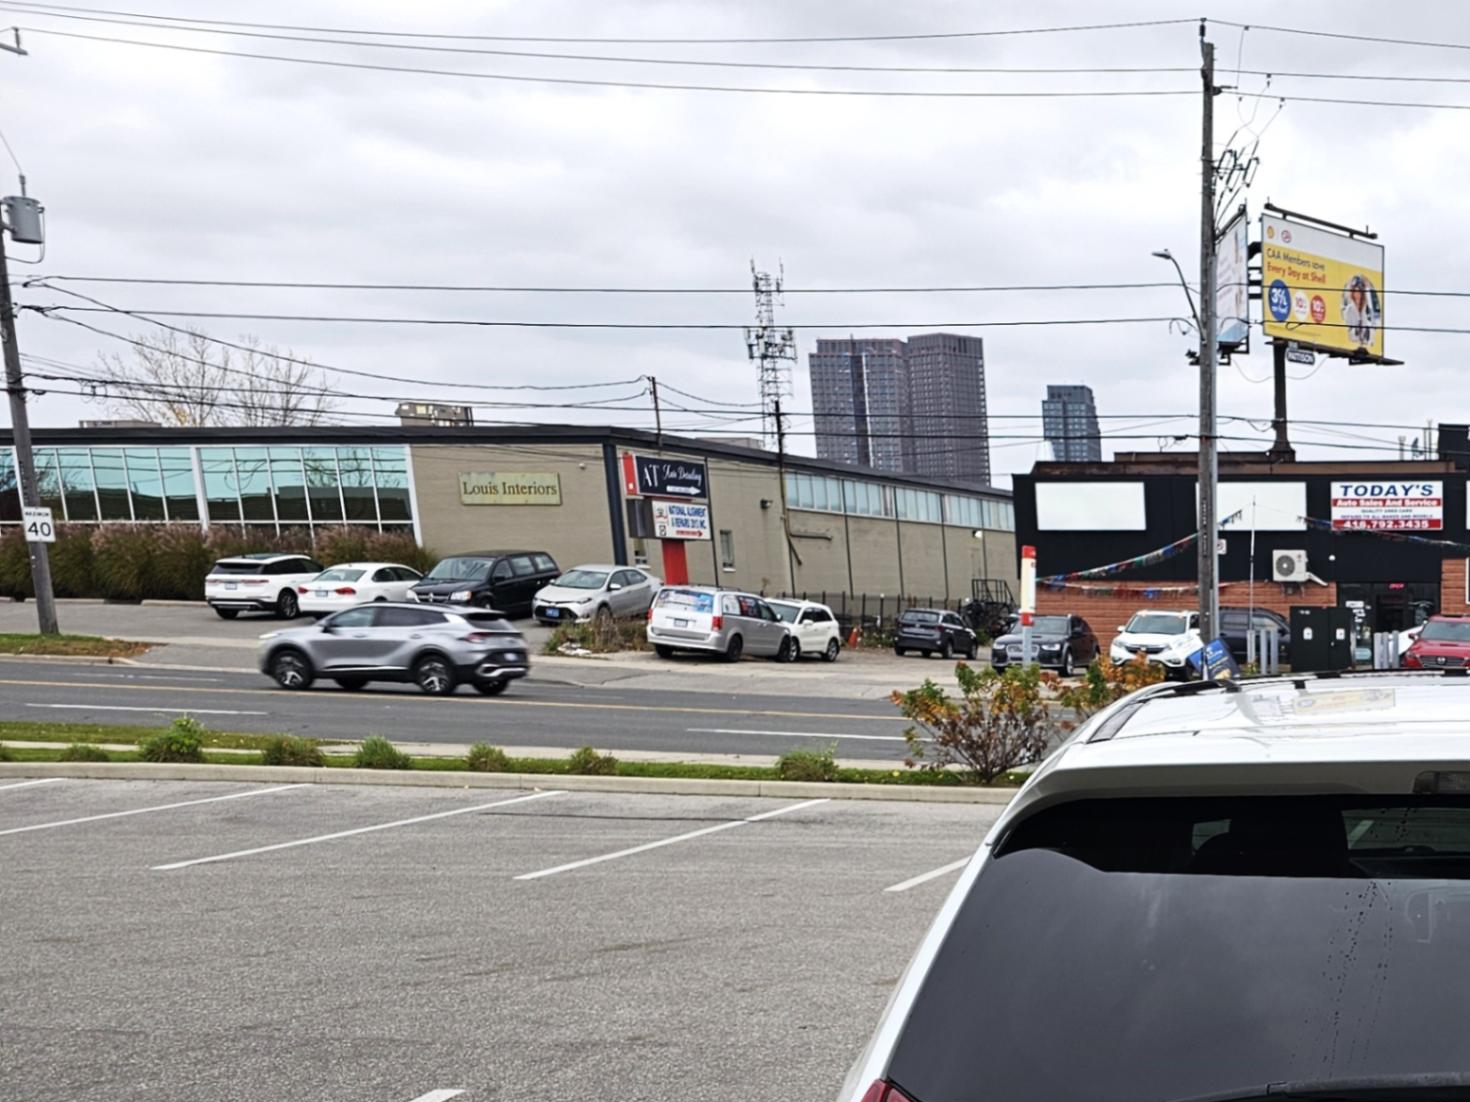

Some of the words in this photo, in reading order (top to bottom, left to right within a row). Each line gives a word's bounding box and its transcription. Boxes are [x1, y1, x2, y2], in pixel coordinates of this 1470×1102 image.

[1266, 248, 1281, 259] CAA
[1283, 254, 1311, 267] Members
[1267, 262, 1286, 277] Every
[1288, 266, 1301, 280] Day
[1311, 272, 1326, 284] Shell
[462, 481, 499, 495] Louis
[502, 481, 558, 495] Interiors
[1340, 484, 1434, 497] TODAY'S
[1336, 499, 1358, 507] Auto
[1359, 499, 1383, 507] Sales
[1384, 499, 1402, 507] And
[1404, 499, 1438, 507] Service
[28, 522, 51, 537] 40
